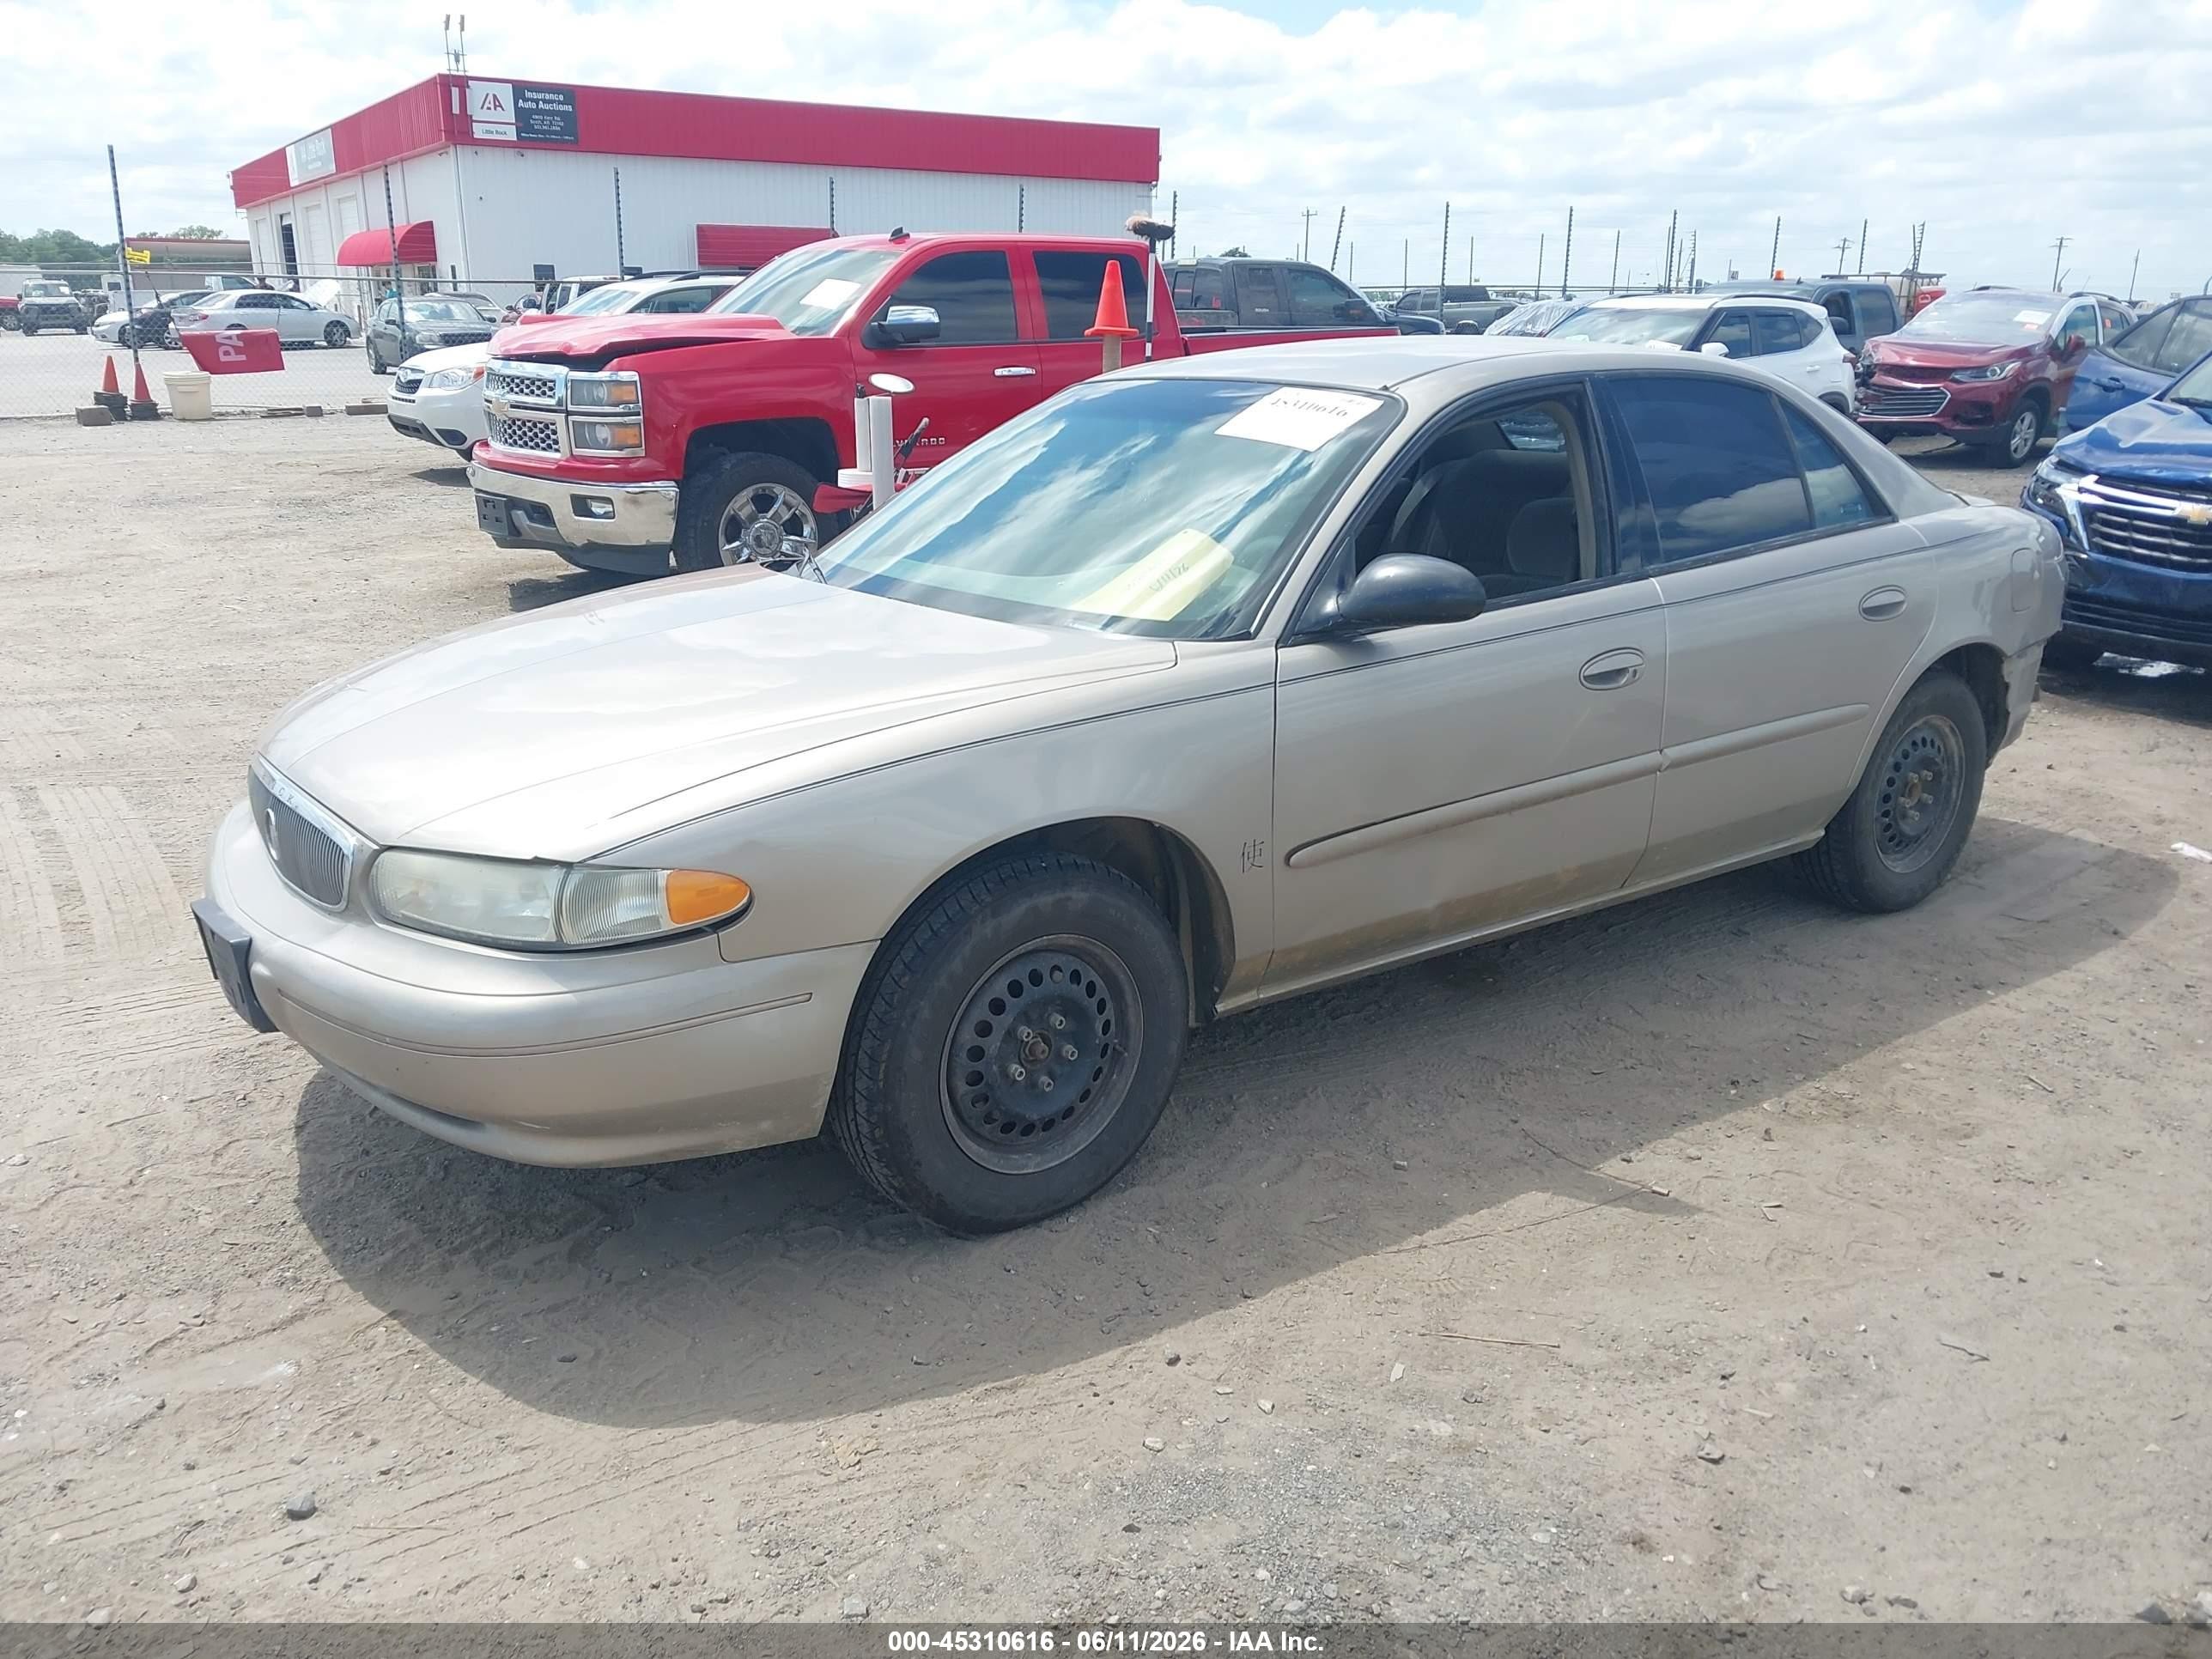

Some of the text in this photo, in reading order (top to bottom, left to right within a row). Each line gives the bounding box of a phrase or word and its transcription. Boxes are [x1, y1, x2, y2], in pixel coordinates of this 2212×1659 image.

[525, 89, 563, 100] Insurance
[518, 99, 573, 112] Auto Auctions
